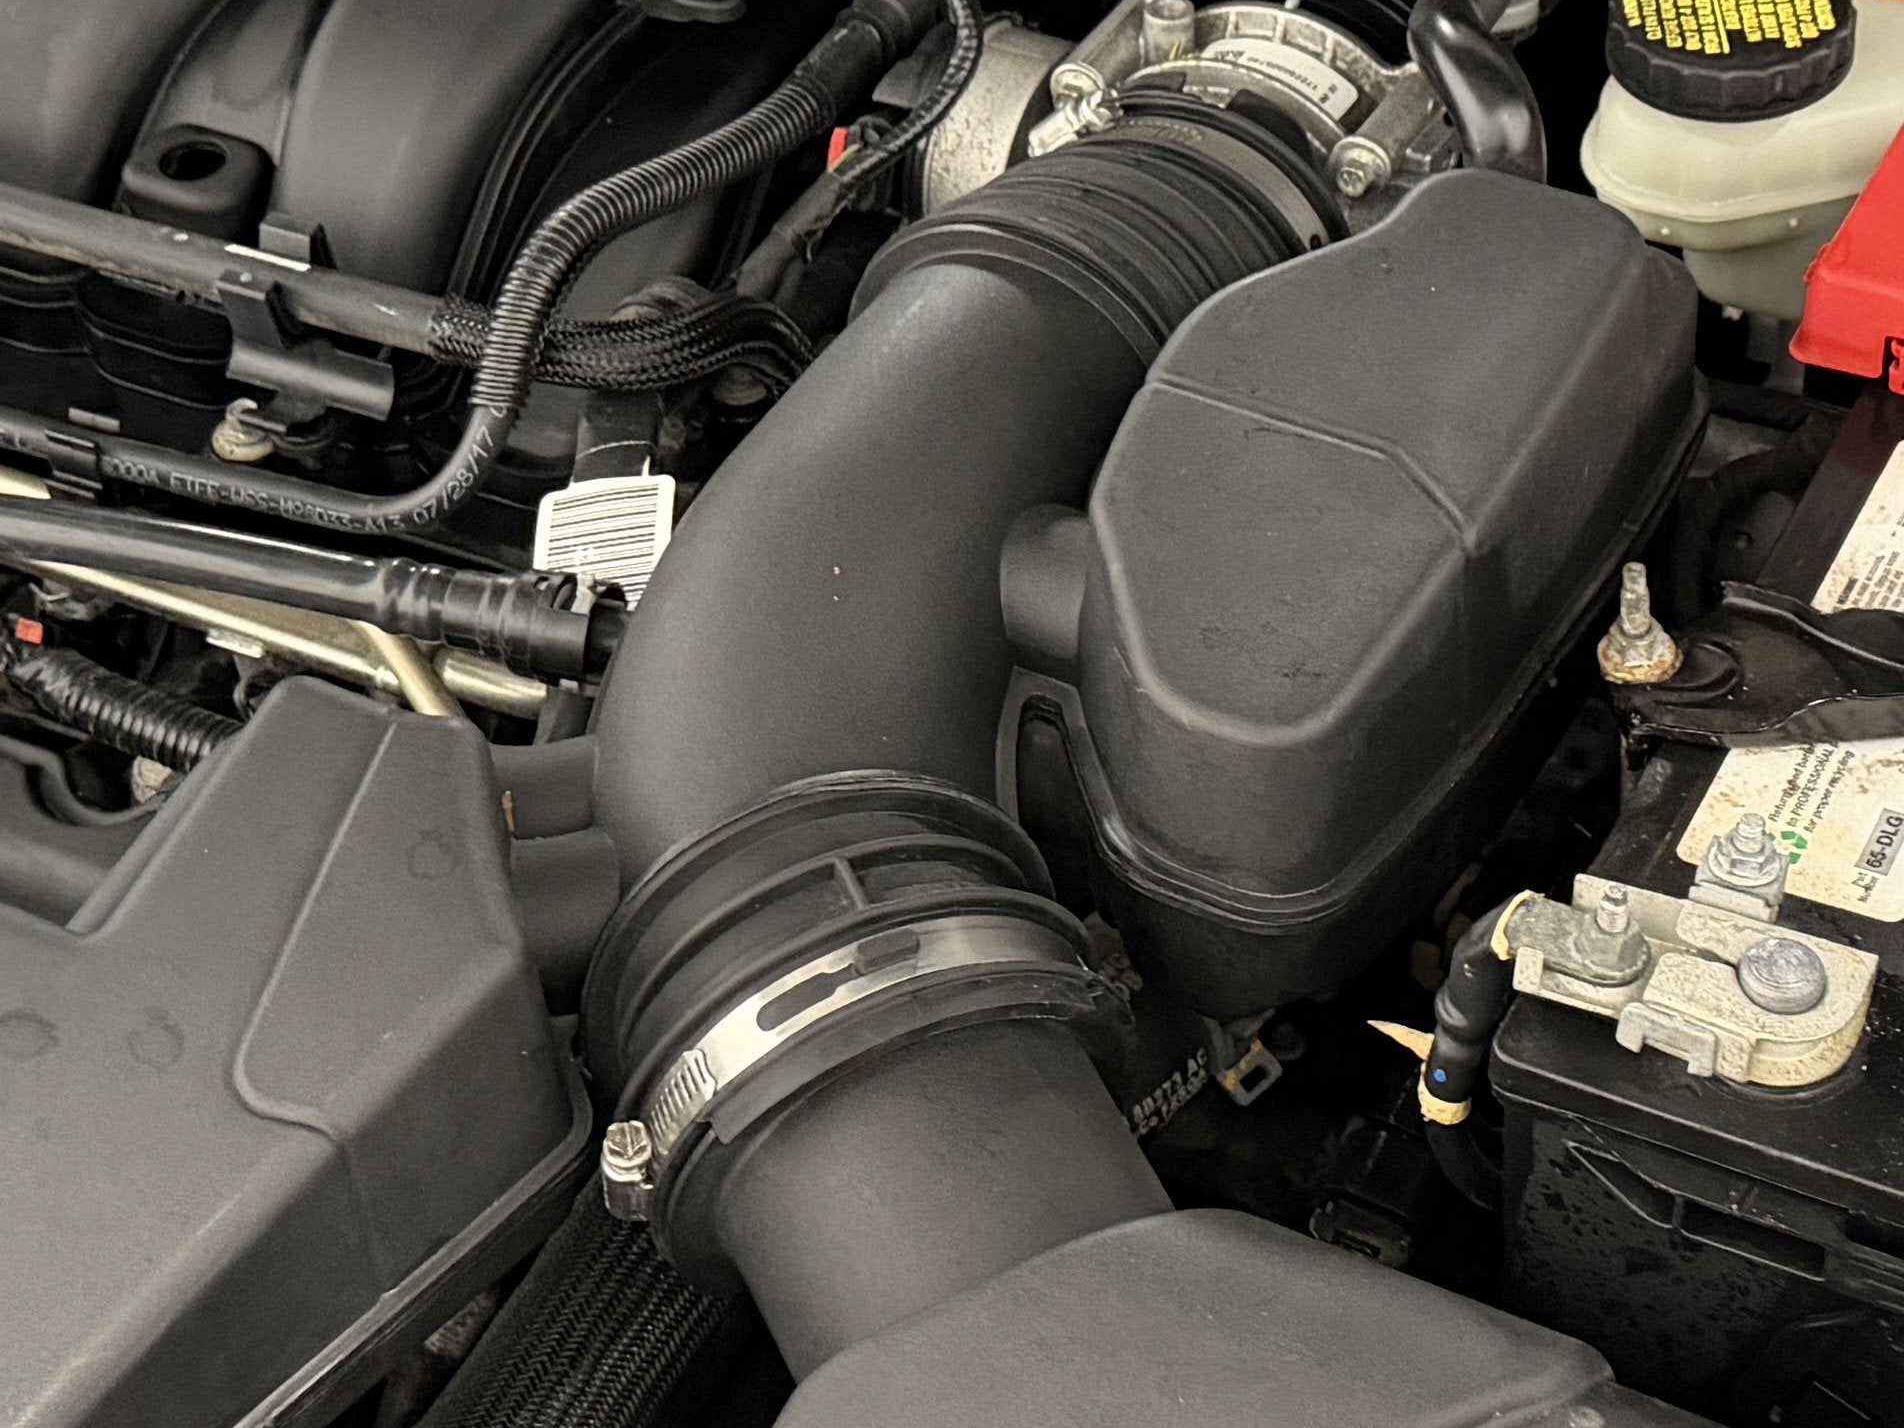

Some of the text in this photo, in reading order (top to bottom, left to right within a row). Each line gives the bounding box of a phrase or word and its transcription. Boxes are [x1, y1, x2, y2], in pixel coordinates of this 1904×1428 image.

[409, 424, 499, 527] 07/28/17
[1790, 746, 1835, 816] PROFESSIONAL
[1802, 818, 1817, 833] for
[1811, 787, 1836, 819] proper
[1827, 749, 1855, 789] recycling
[1786, 816, 1799, 827] to
[1865, 812, 1904, 870] 65-DLG
